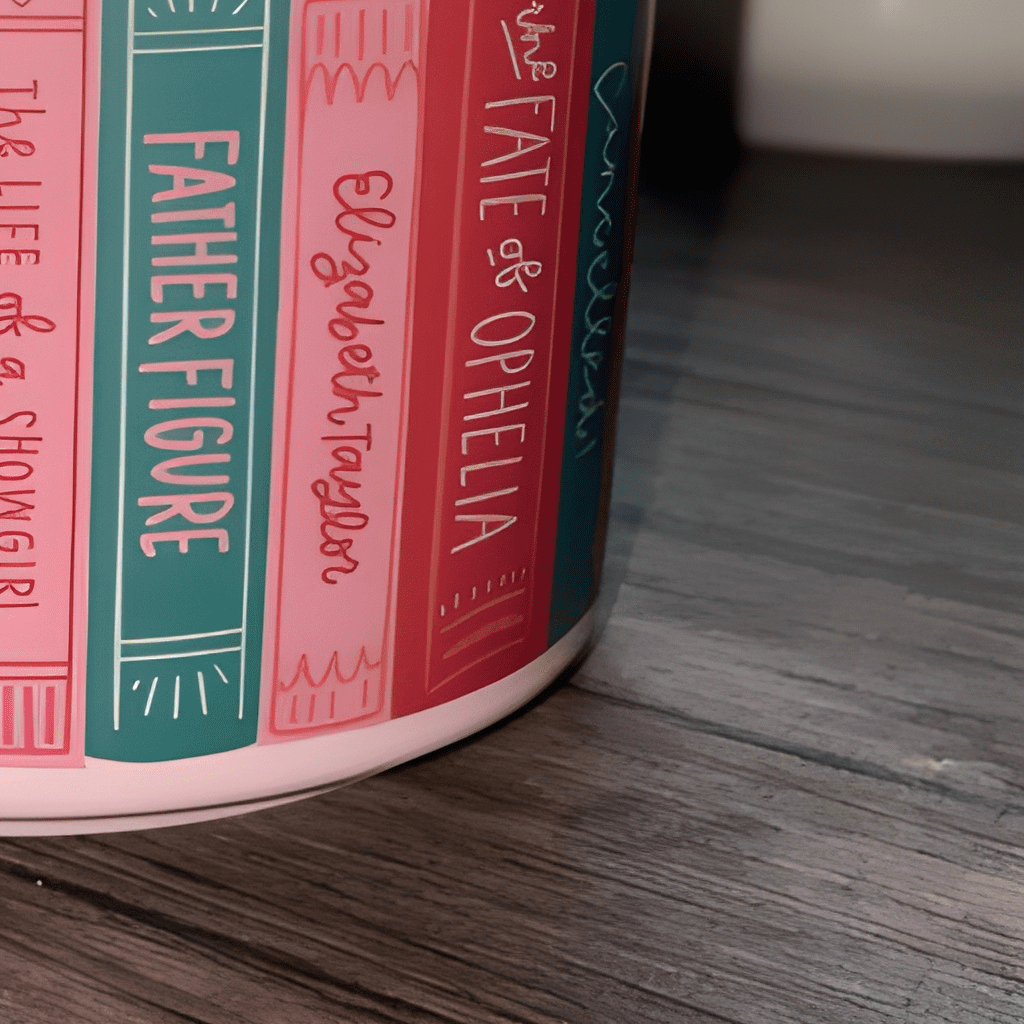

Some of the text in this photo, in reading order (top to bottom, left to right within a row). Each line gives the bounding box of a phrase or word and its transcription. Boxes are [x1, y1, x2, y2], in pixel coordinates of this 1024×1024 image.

[138, 130, 241, 558] FATHER FIGURE
[310, 169, 395, 585] Elizabeth Taylor
[451, 1, 558, 556] the FATE of OPHELIA
